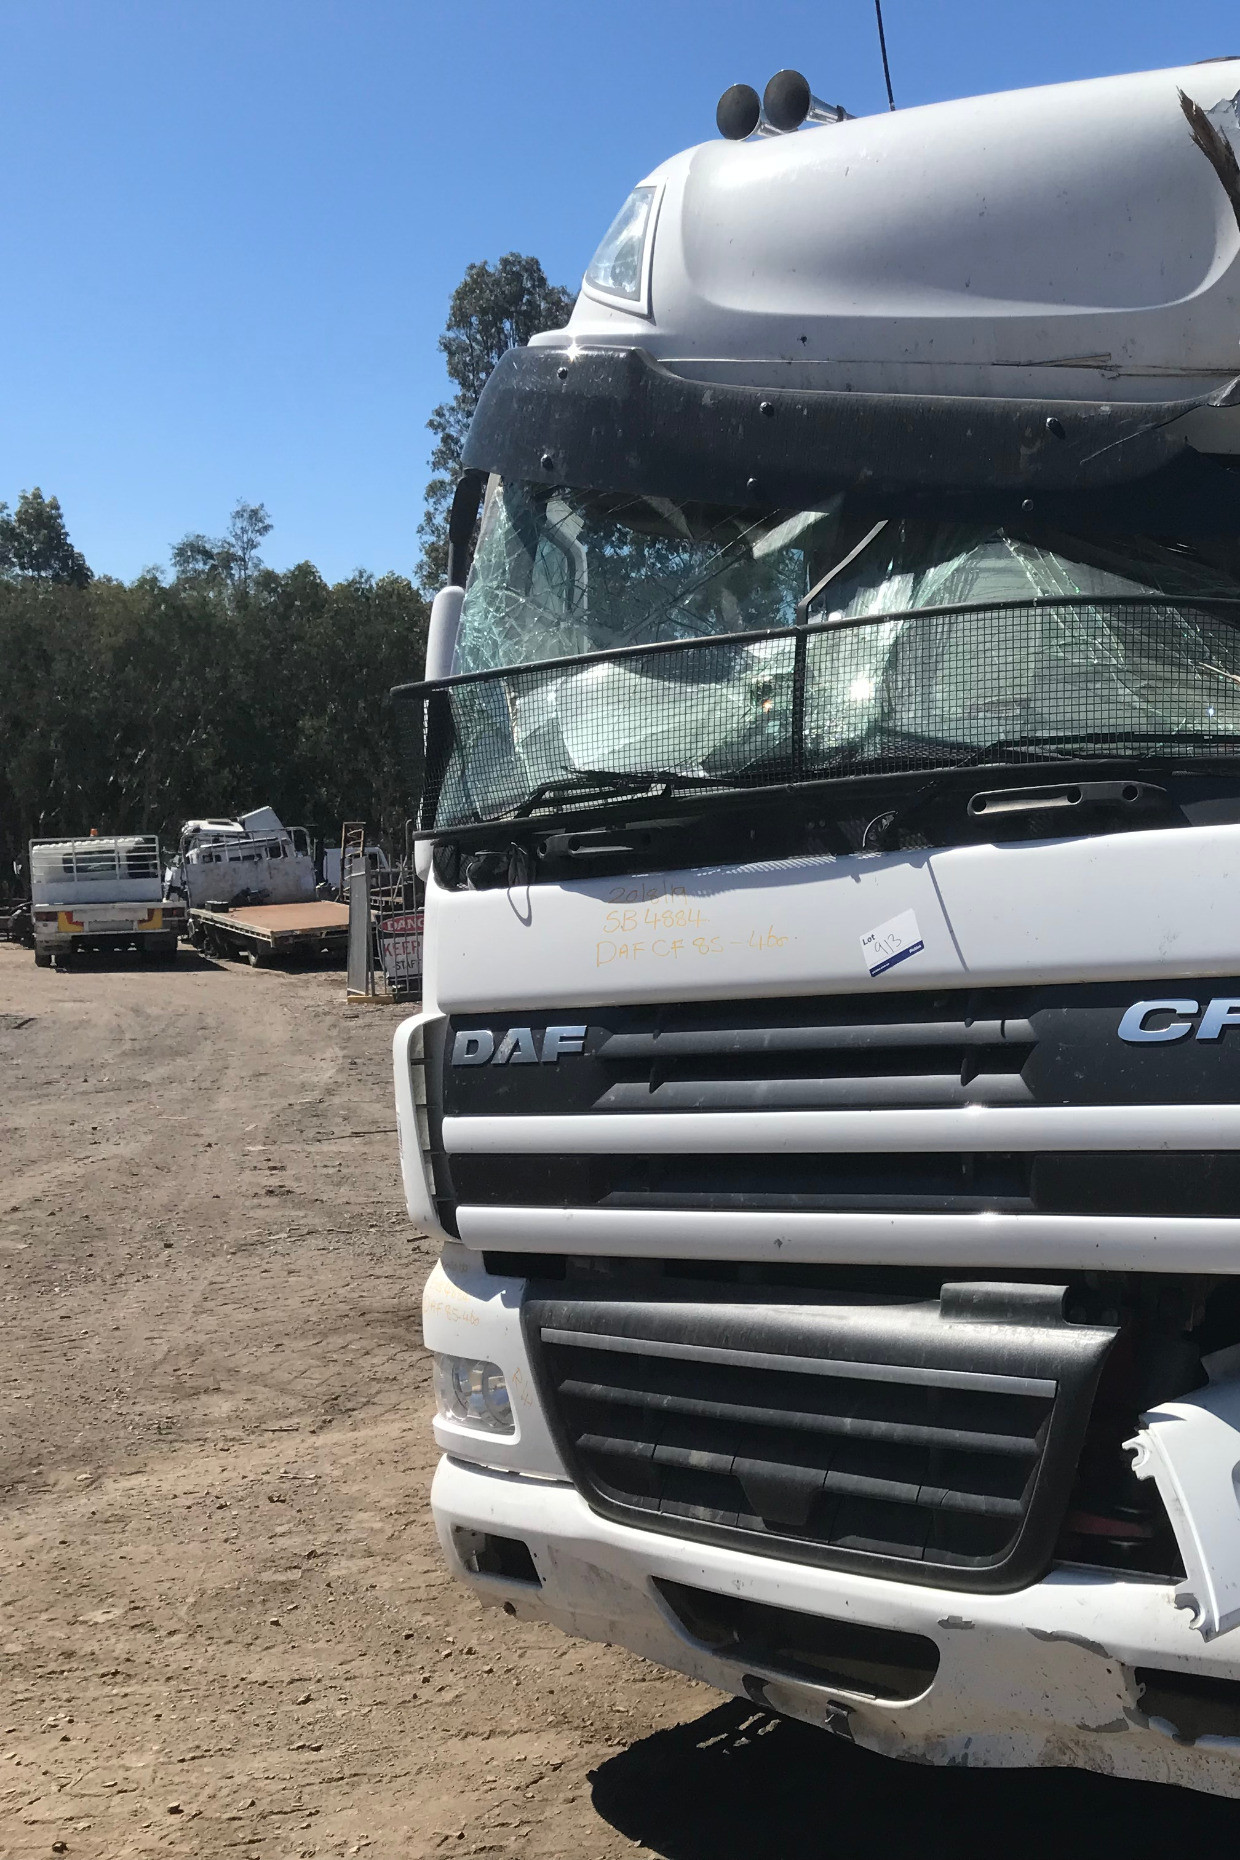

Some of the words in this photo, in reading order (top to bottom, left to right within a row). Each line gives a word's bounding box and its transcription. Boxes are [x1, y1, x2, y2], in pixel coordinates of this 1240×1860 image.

[608, 880, 687, 905] 20/8/19
[862, 934, 876, 945] Lot
[875, 934, 902, 955] 913
[395, 960, 422, 970] STAF
[451, 1025, 588, 1066] DAF
